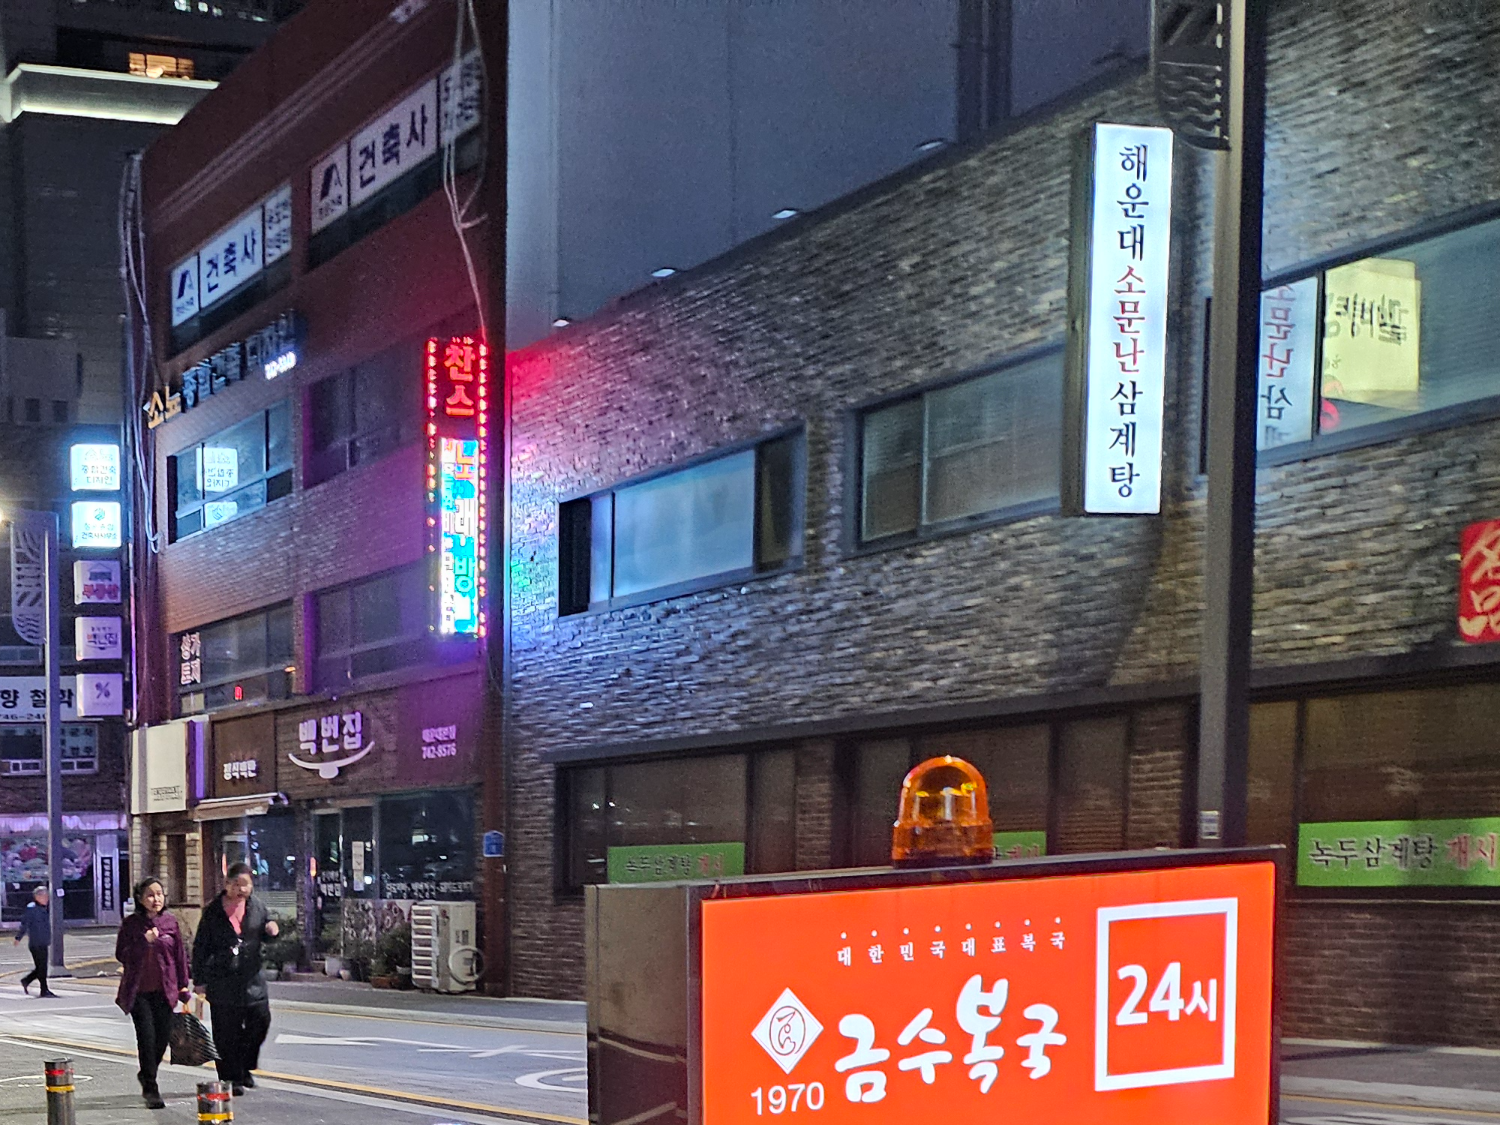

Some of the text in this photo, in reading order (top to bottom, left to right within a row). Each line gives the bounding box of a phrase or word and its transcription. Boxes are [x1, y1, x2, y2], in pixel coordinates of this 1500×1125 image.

[359, 103, 428, 189] 건축사
[206, 227, 257, 294] 건축사
[444, 344, 476, 416] 찬스
[1310, 834, 1438, 870] 녹두삼계탕
[1115, 962, 1218, 1026] 24시
[835, 974, 1068, 1104] 금수복국
[750, 1081, 825, 1116] 1970
